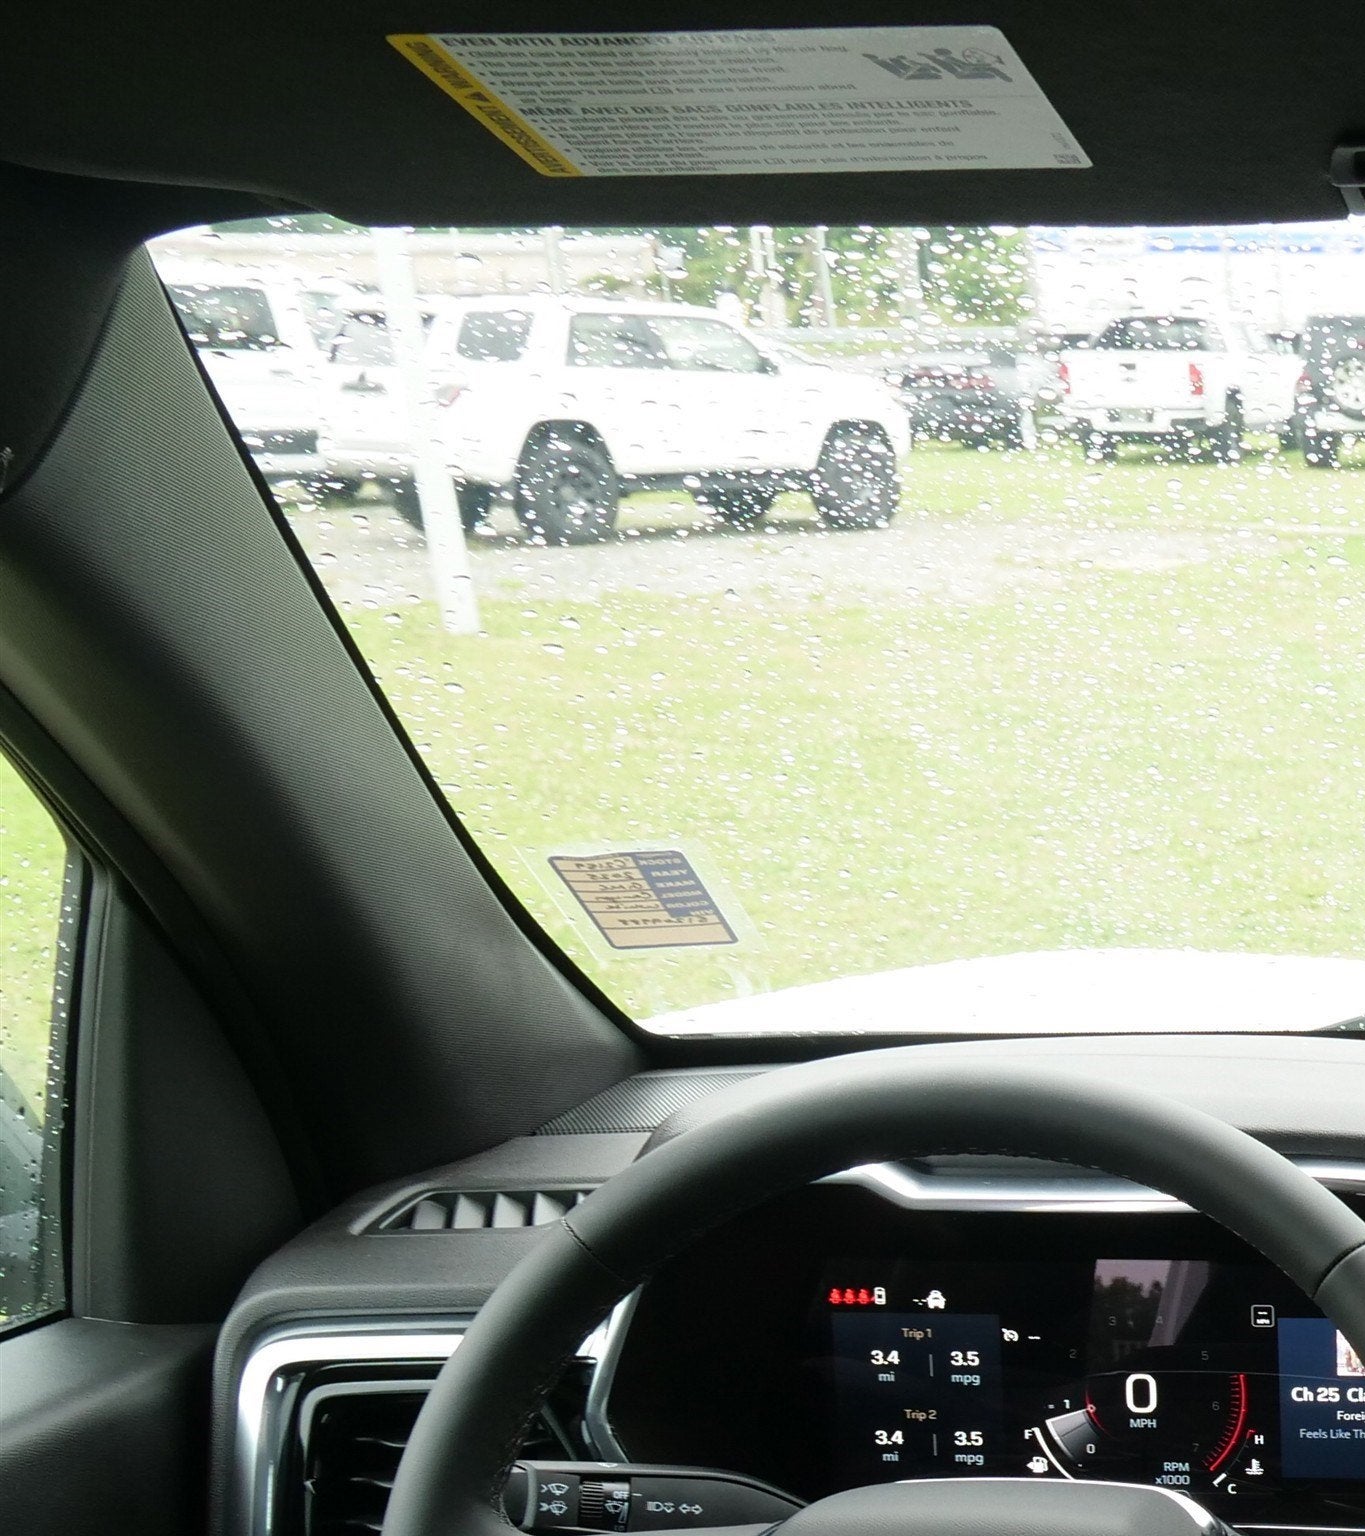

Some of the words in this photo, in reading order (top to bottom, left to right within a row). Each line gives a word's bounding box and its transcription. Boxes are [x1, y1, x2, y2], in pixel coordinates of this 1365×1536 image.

[901, 1328, 925, 1340] Trip
[926, 1328, 932, 1338] 1
[870, 1350, 900, 1365] 3.4
[950, 1351, 980, 1366] 3.5
[878, 1371, 895, 1382] mi
[951, 1373, 981, 1385] mpg
[1125, 1373, 1158, 1413] 0
[1291, 1386, 1314, 1402] Ch
[1316, 1387, 1340, 1402] 25
[904, 1409, 927, 1421] Trip
[928, 1410, 937, 1420] 2
[1129, 1418, 1157, 1428] MPH
[874, 1430, 905, 1446] 3.4
[954, 1431, 984, 1446] 3.5
[1024, 1429, 1033, 1439] F
[1255, 1435, 1264, 1444] H
[1300, 1428, 1328, 1439] Feels
[1330, 1429, 1351, 1438] Like
[882, 1451, 899, 1462] mi
[955, 1453, 984, 1465] mpg
[1164, 1462, 1189, 1472] RPM
[1155, 1475, 1190, 1485] x1000
[1227, 1483, 1237, 1494] C
